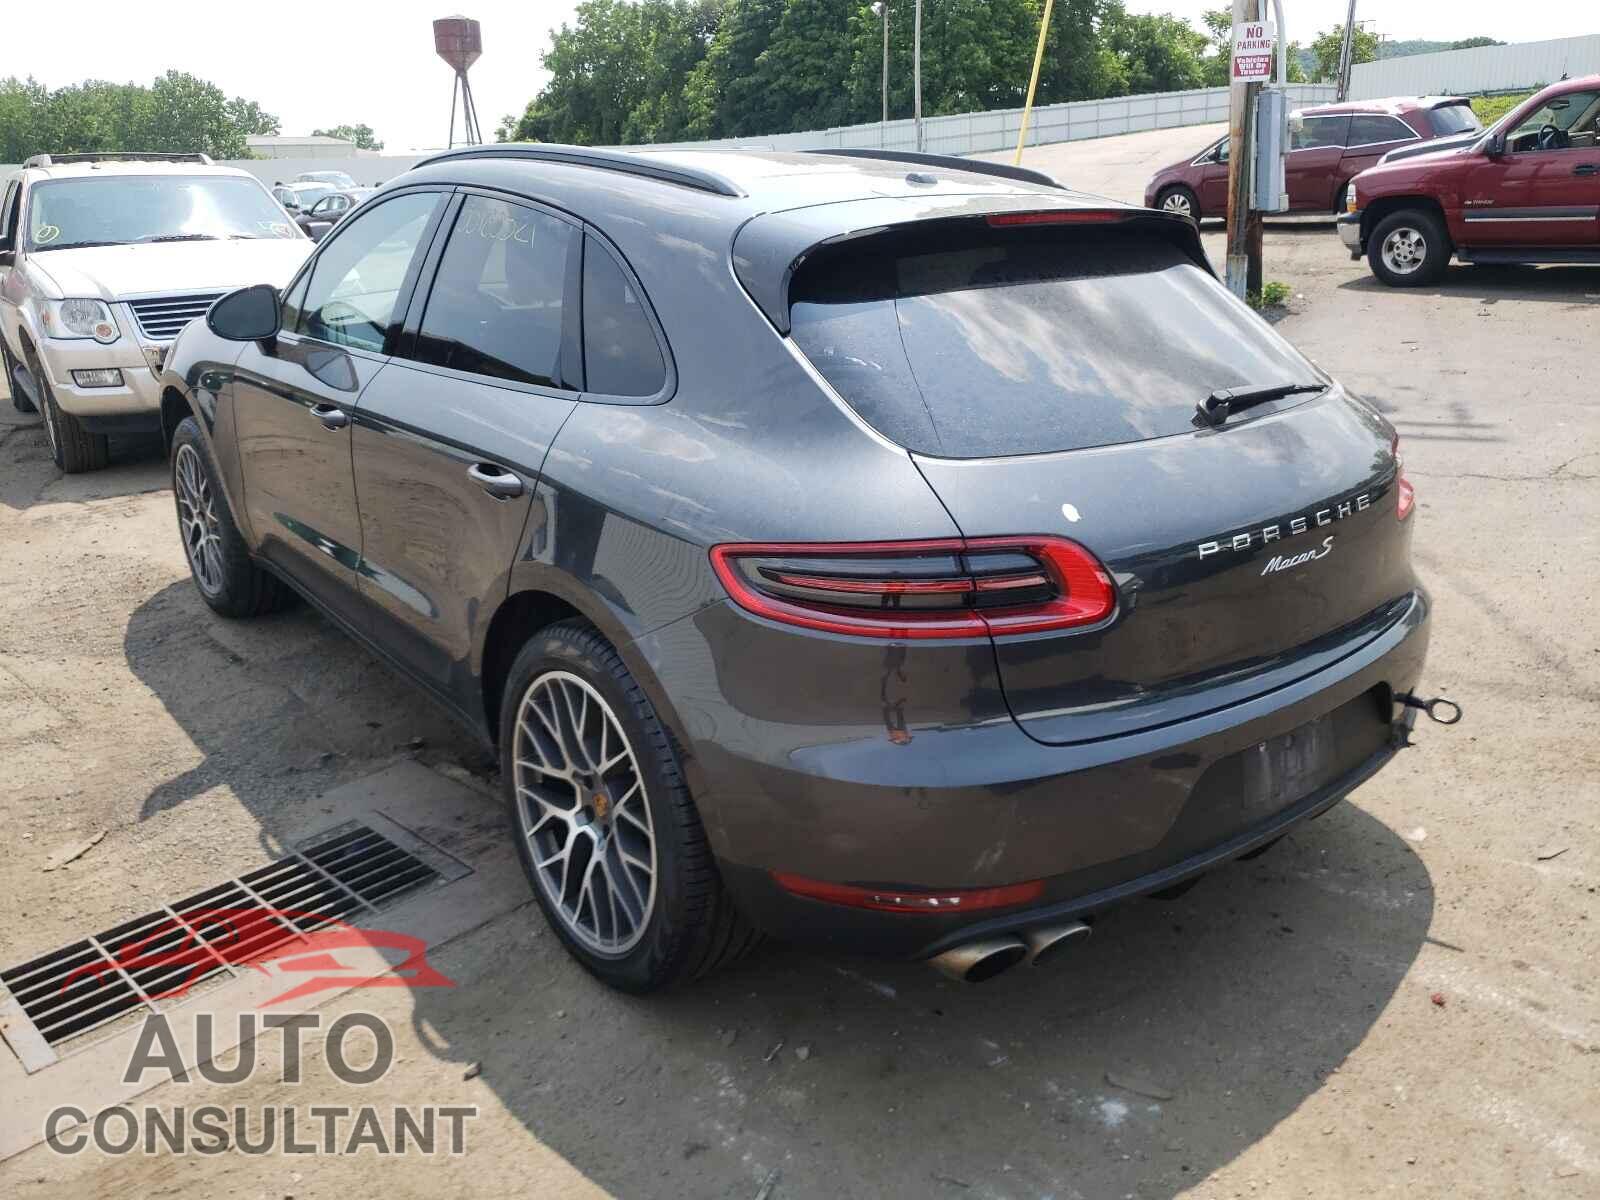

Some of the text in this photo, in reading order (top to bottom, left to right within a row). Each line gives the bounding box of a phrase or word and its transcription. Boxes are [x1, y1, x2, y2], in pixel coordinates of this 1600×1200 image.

[1237, 40, 1270, 49] PARKING
[1246, 26, 1263, 38] NO
[1198, 494, 1371, 560] PORSCHE
[1260, 535, 1335, 576] Macan S
